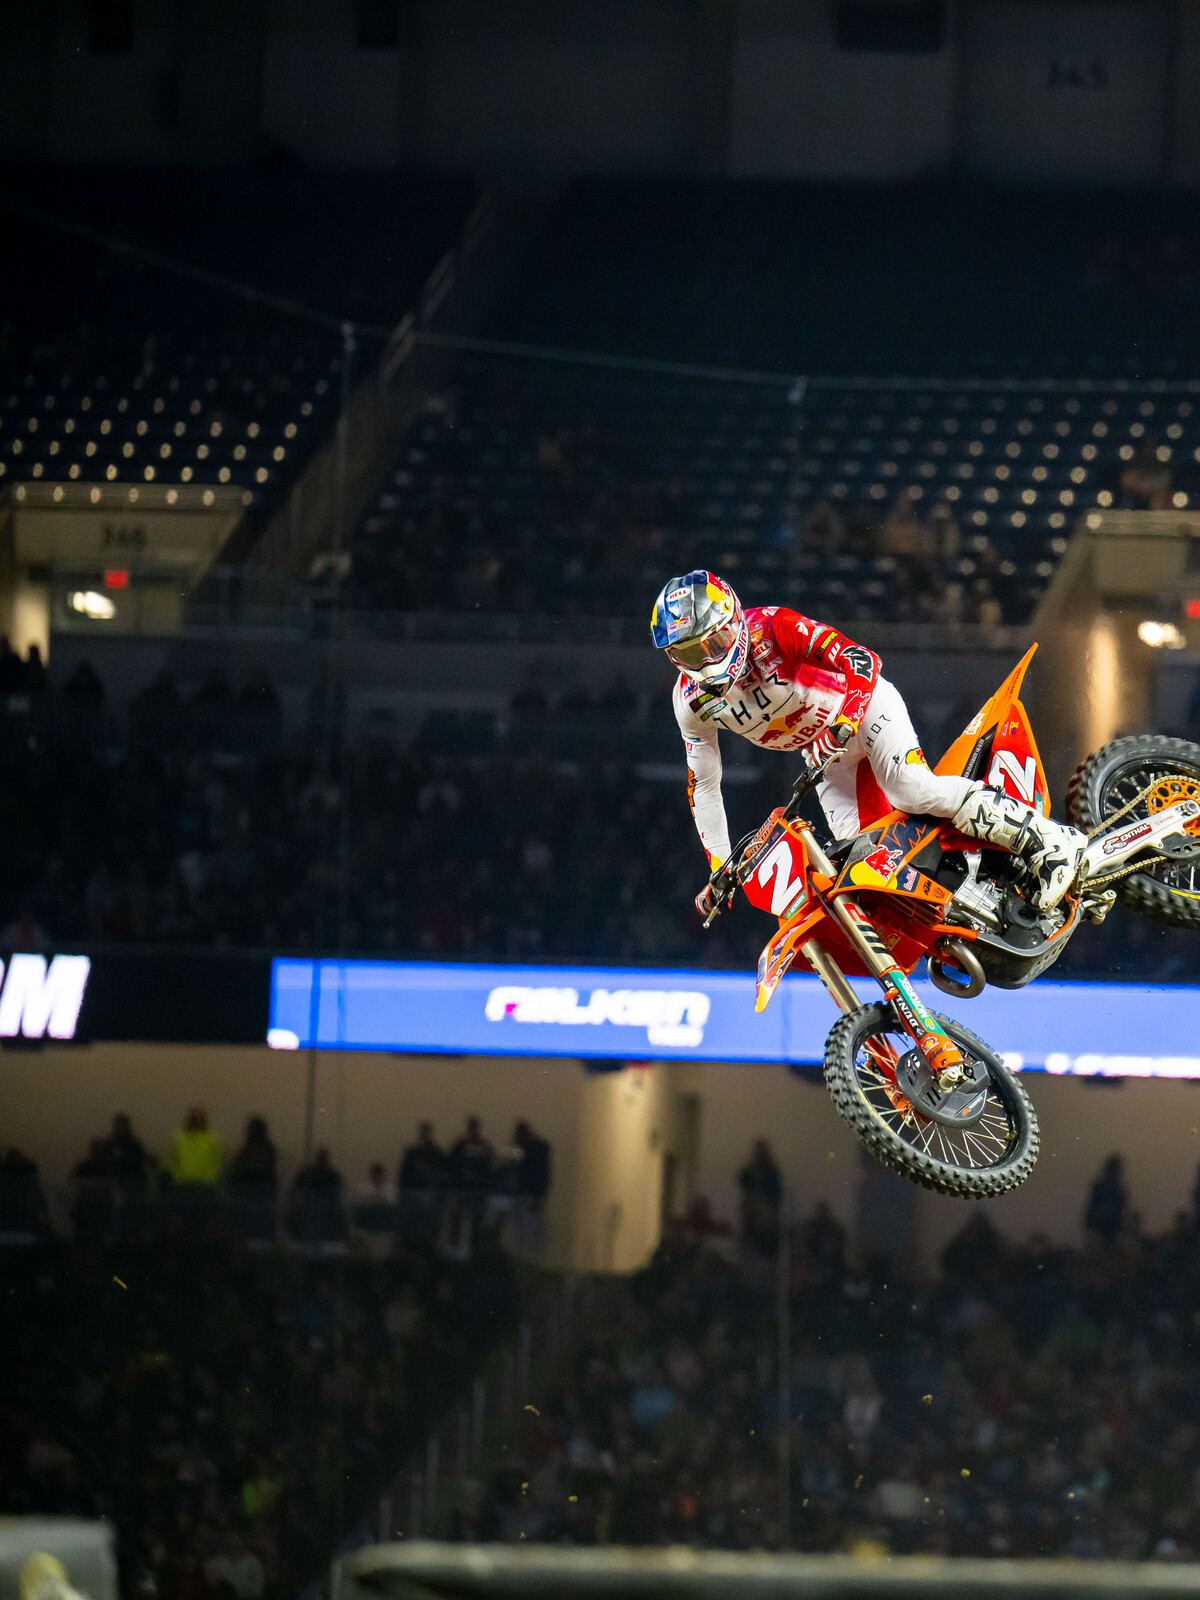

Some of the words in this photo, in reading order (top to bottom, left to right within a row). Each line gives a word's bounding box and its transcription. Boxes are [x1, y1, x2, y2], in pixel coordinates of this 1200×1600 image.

[669, 589, 688, 600] BELL
[752, 641, 771, 658] BELL
[803, 707, 831, 739] Bull
[988, 750, 1037, 803] 2
[758, 840, 803, 917] 2
[884, 979, 920, 1028] DUNLP
[898, 976, 930, 1019] MOTOREX
